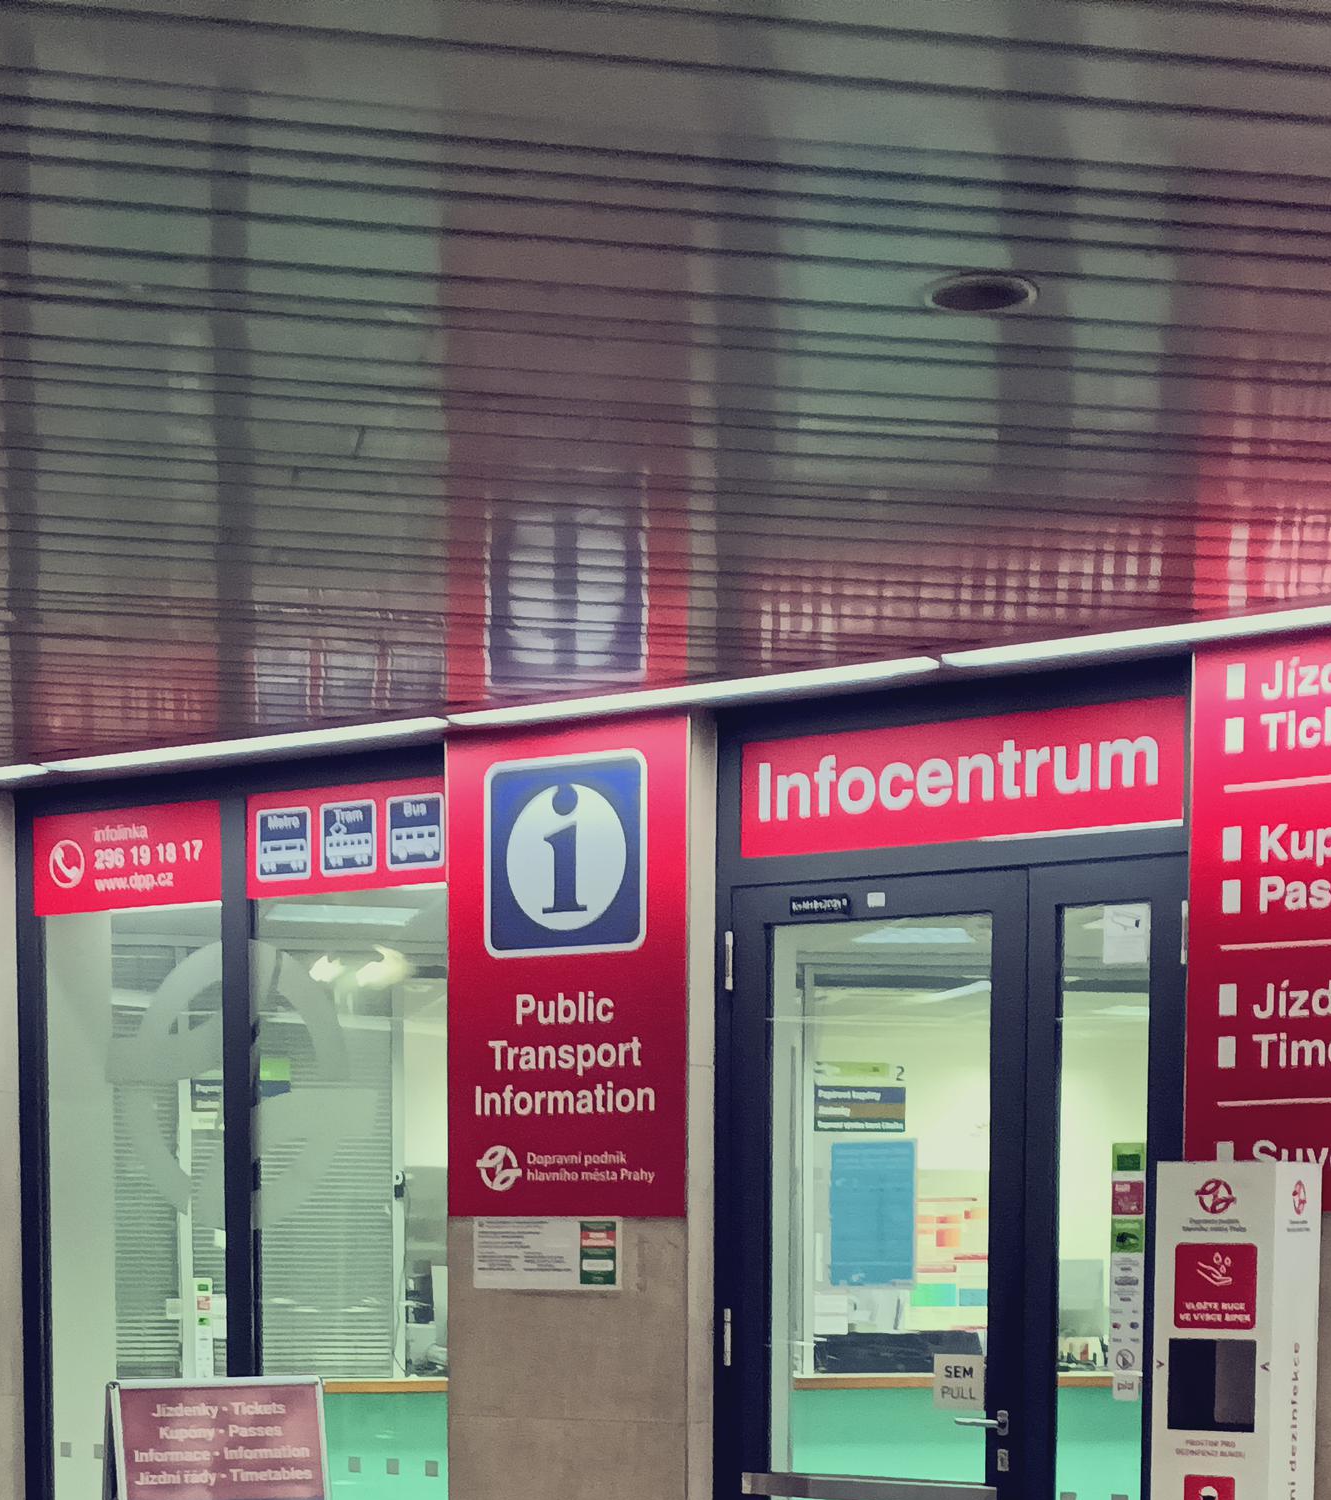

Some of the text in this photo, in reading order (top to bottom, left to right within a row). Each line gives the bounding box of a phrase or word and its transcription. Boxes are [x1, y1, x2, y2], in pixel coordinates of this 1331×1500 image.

[757, 734, 1160, 823] Infocentrum
[333, 809, 363, 824] Tram
[403, 802, 427, 817] Bus
[267, 815, 301, 830] Metro
[94, 839, 203, 870] 296 19 18 17
[94, 872, 174, 892] www.dpp.cz
[515, 991, 616, 1026] Public
[488, 1036, 642, 1077] Transport
[474, 1081, 656, 1118] Information
[526, 1151, 627, 1168] Dopravní podnik
[526, 1168, 656, 1185] hlavního města Prahy
[944, 1365, 974, 1379] SEM
[941, 1386, 977, 1400] PULL
[152, 1402, 286, 1419] Jízdenky Tickets
[228, 1424, 283, 1438] Passes
[134, 1446, 310, 1463] Informace Information
[135, 1467, 313, 1486] Jízdní řády Timetables
